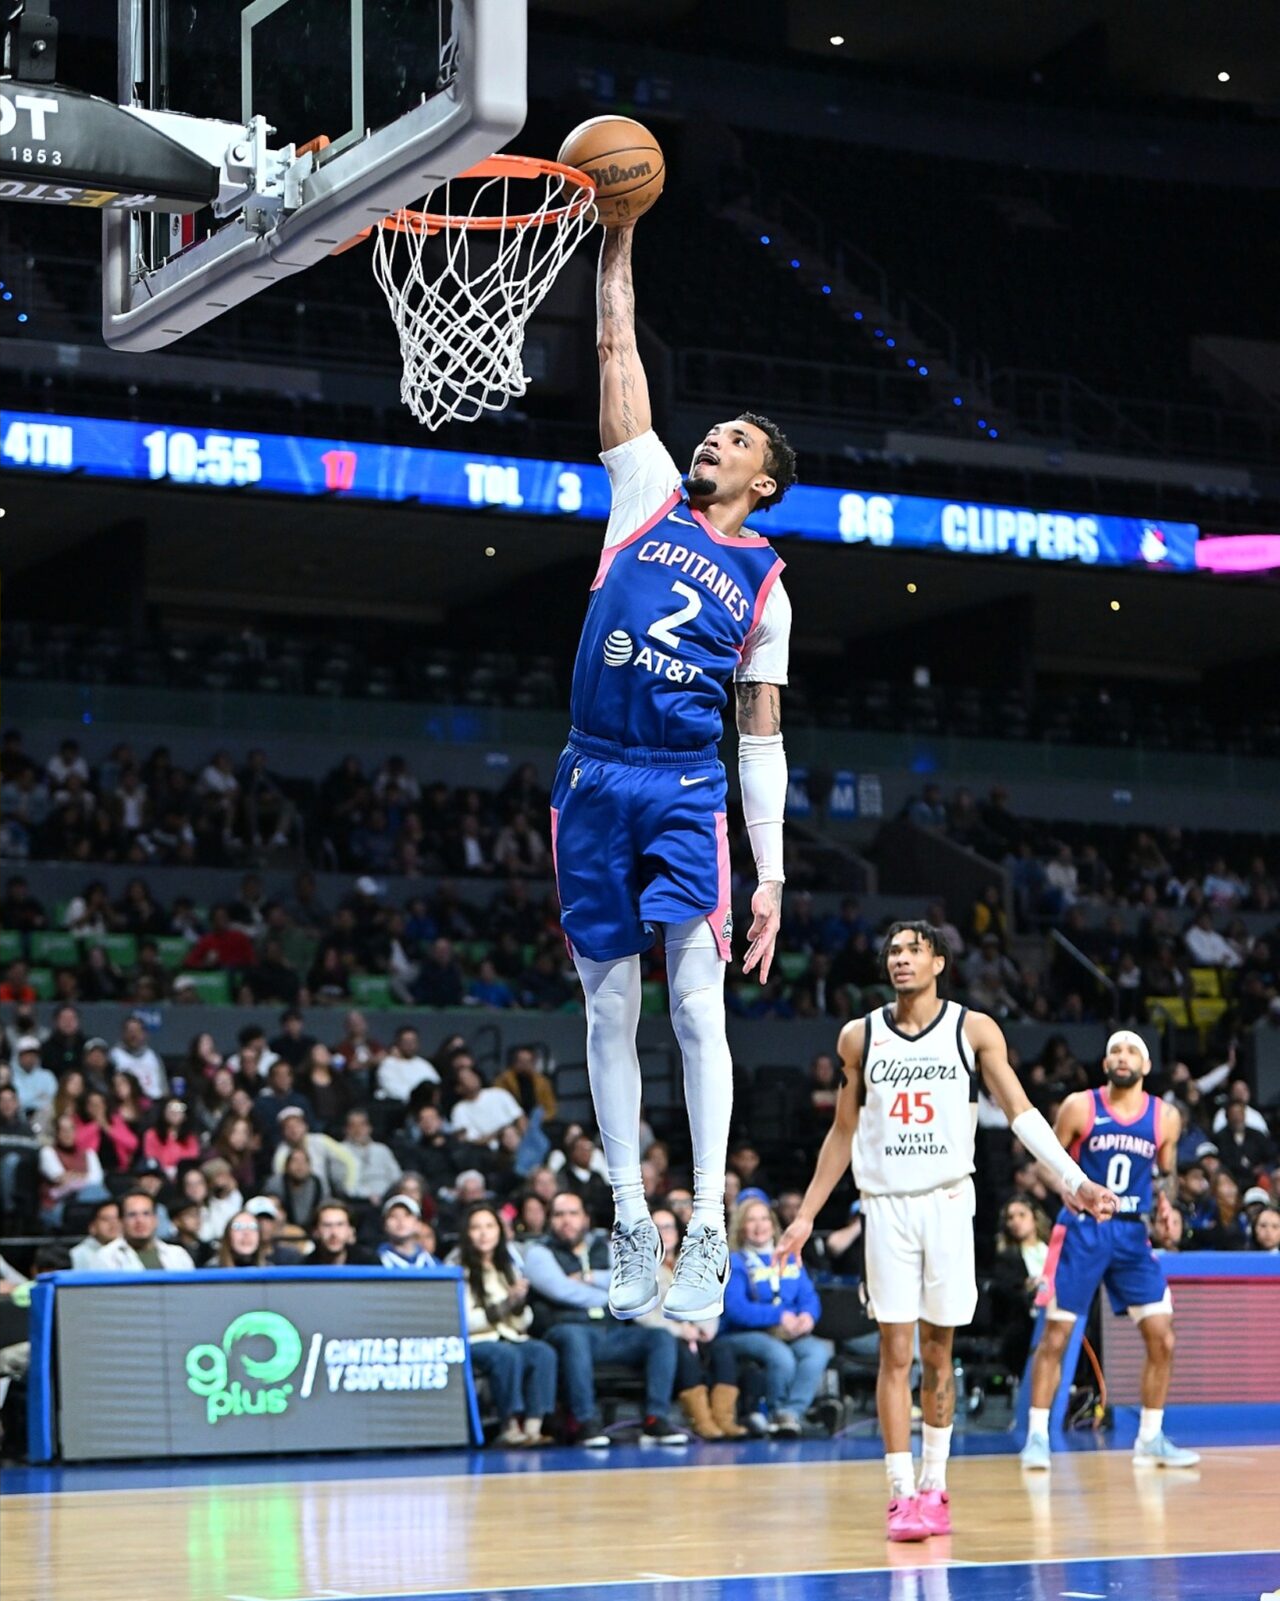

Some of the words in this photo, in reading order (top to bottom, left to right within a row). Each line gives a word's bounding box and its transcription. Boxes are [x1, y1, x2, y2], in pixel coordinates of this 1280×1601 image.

[10, 146, 62, 165] 1853
[4, 421, 73, 467] 4TH
[143, 430, 262, 487] 10:55
[321, 450, 358, 490] 17
[554, 472, 582, 511] 3
[838, 494, 894, 547] 86
[941, 504, 1099, 563] CLIPPERS
[637, 540, 750, 622] CAPITANES
[647, 580, 703, 649] 2
[633, 647, 704, 684] AT&T
[870, 1059, 958, 1088] Clippers
[889, 1091, 935, 1125] 45
[885, 1144, 949, 1157] RWANDA
[898, 1133, 935, 1143] VISIT
[1089, 1134, 1156, 1157] CAPITANES
[1106, 1153, 1132, 1194] 0
[327, 1364, 344, 1392] Y
[207, 1380, 293, 1424] plus
